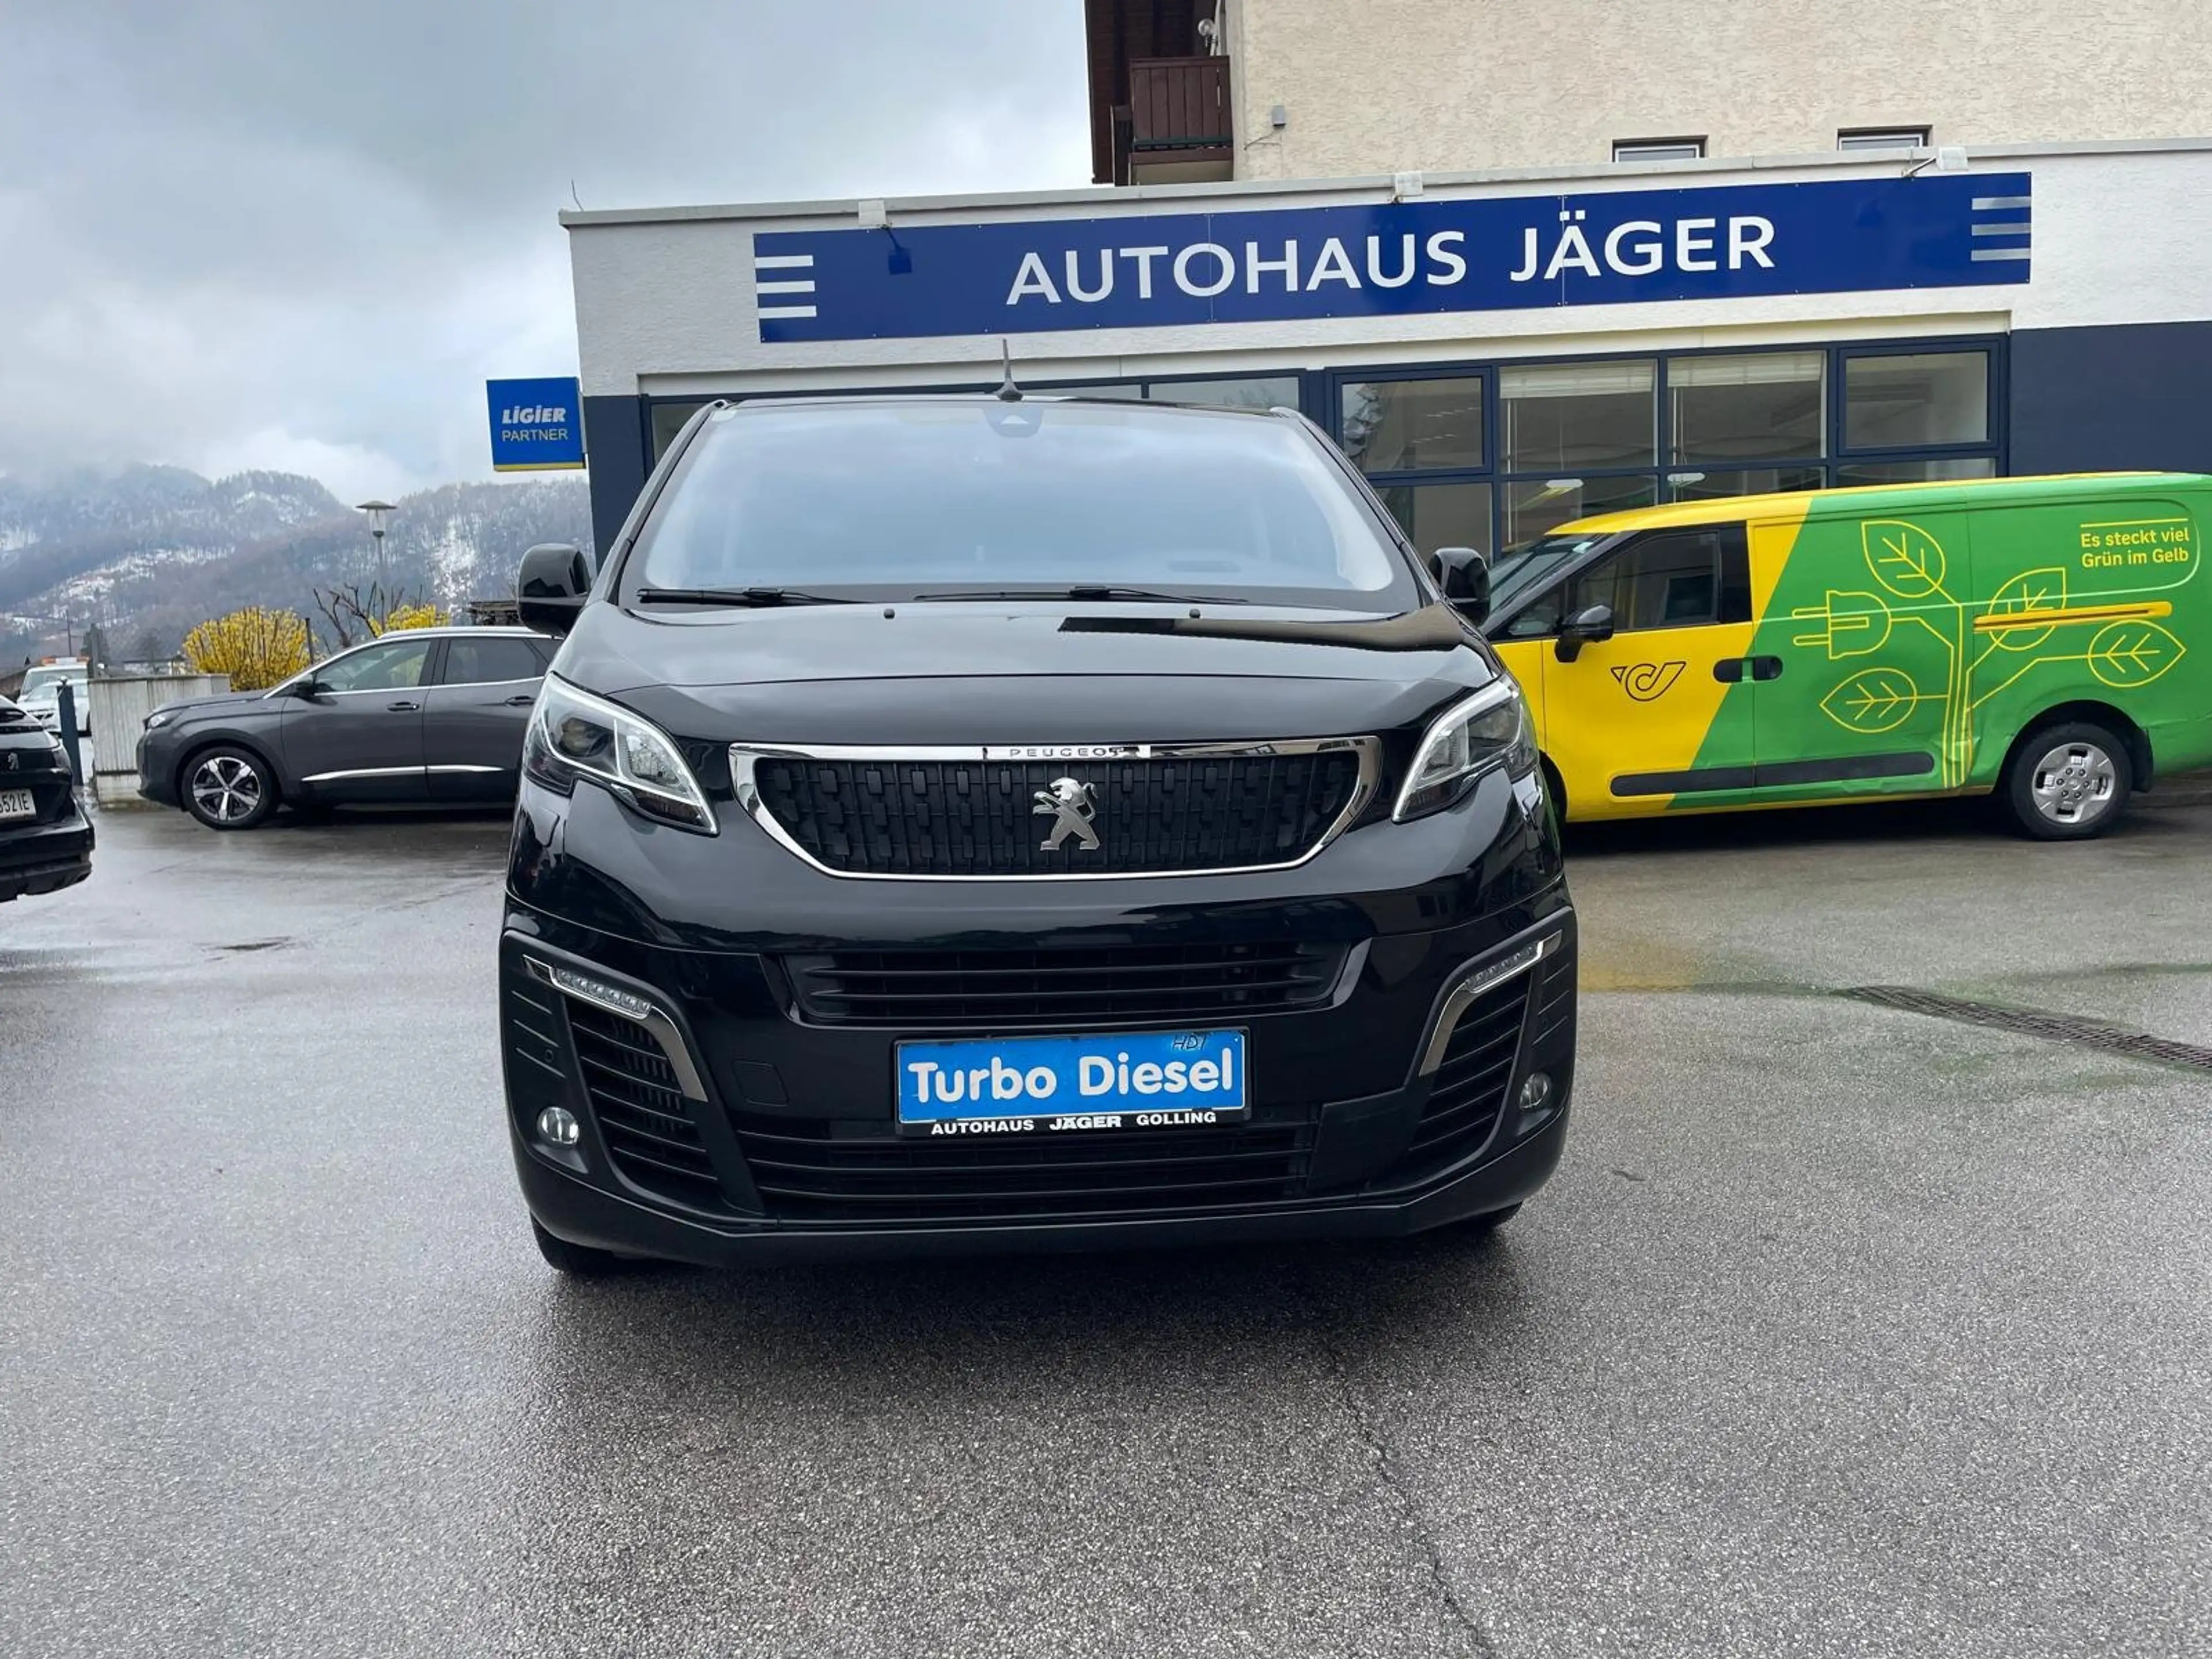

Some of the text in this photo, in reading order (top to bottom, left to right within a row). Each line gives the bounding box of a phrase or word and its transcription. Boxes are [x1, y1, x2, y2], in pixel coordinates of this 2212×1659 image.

[1006, 210, 1775, 305] AUTOHAUS JÄGER
[502, 428, 568, 442] PARTNER
[2081, 527, 2190, 548] Es steckt viel
[2081, 547, 2189, 568] Grün im Gelb
[907, 1047, 1233, 1103] Turbo Diesel
[930, 1111, 1217, 1135] AUTOHAUS JÄGER GOLLING
